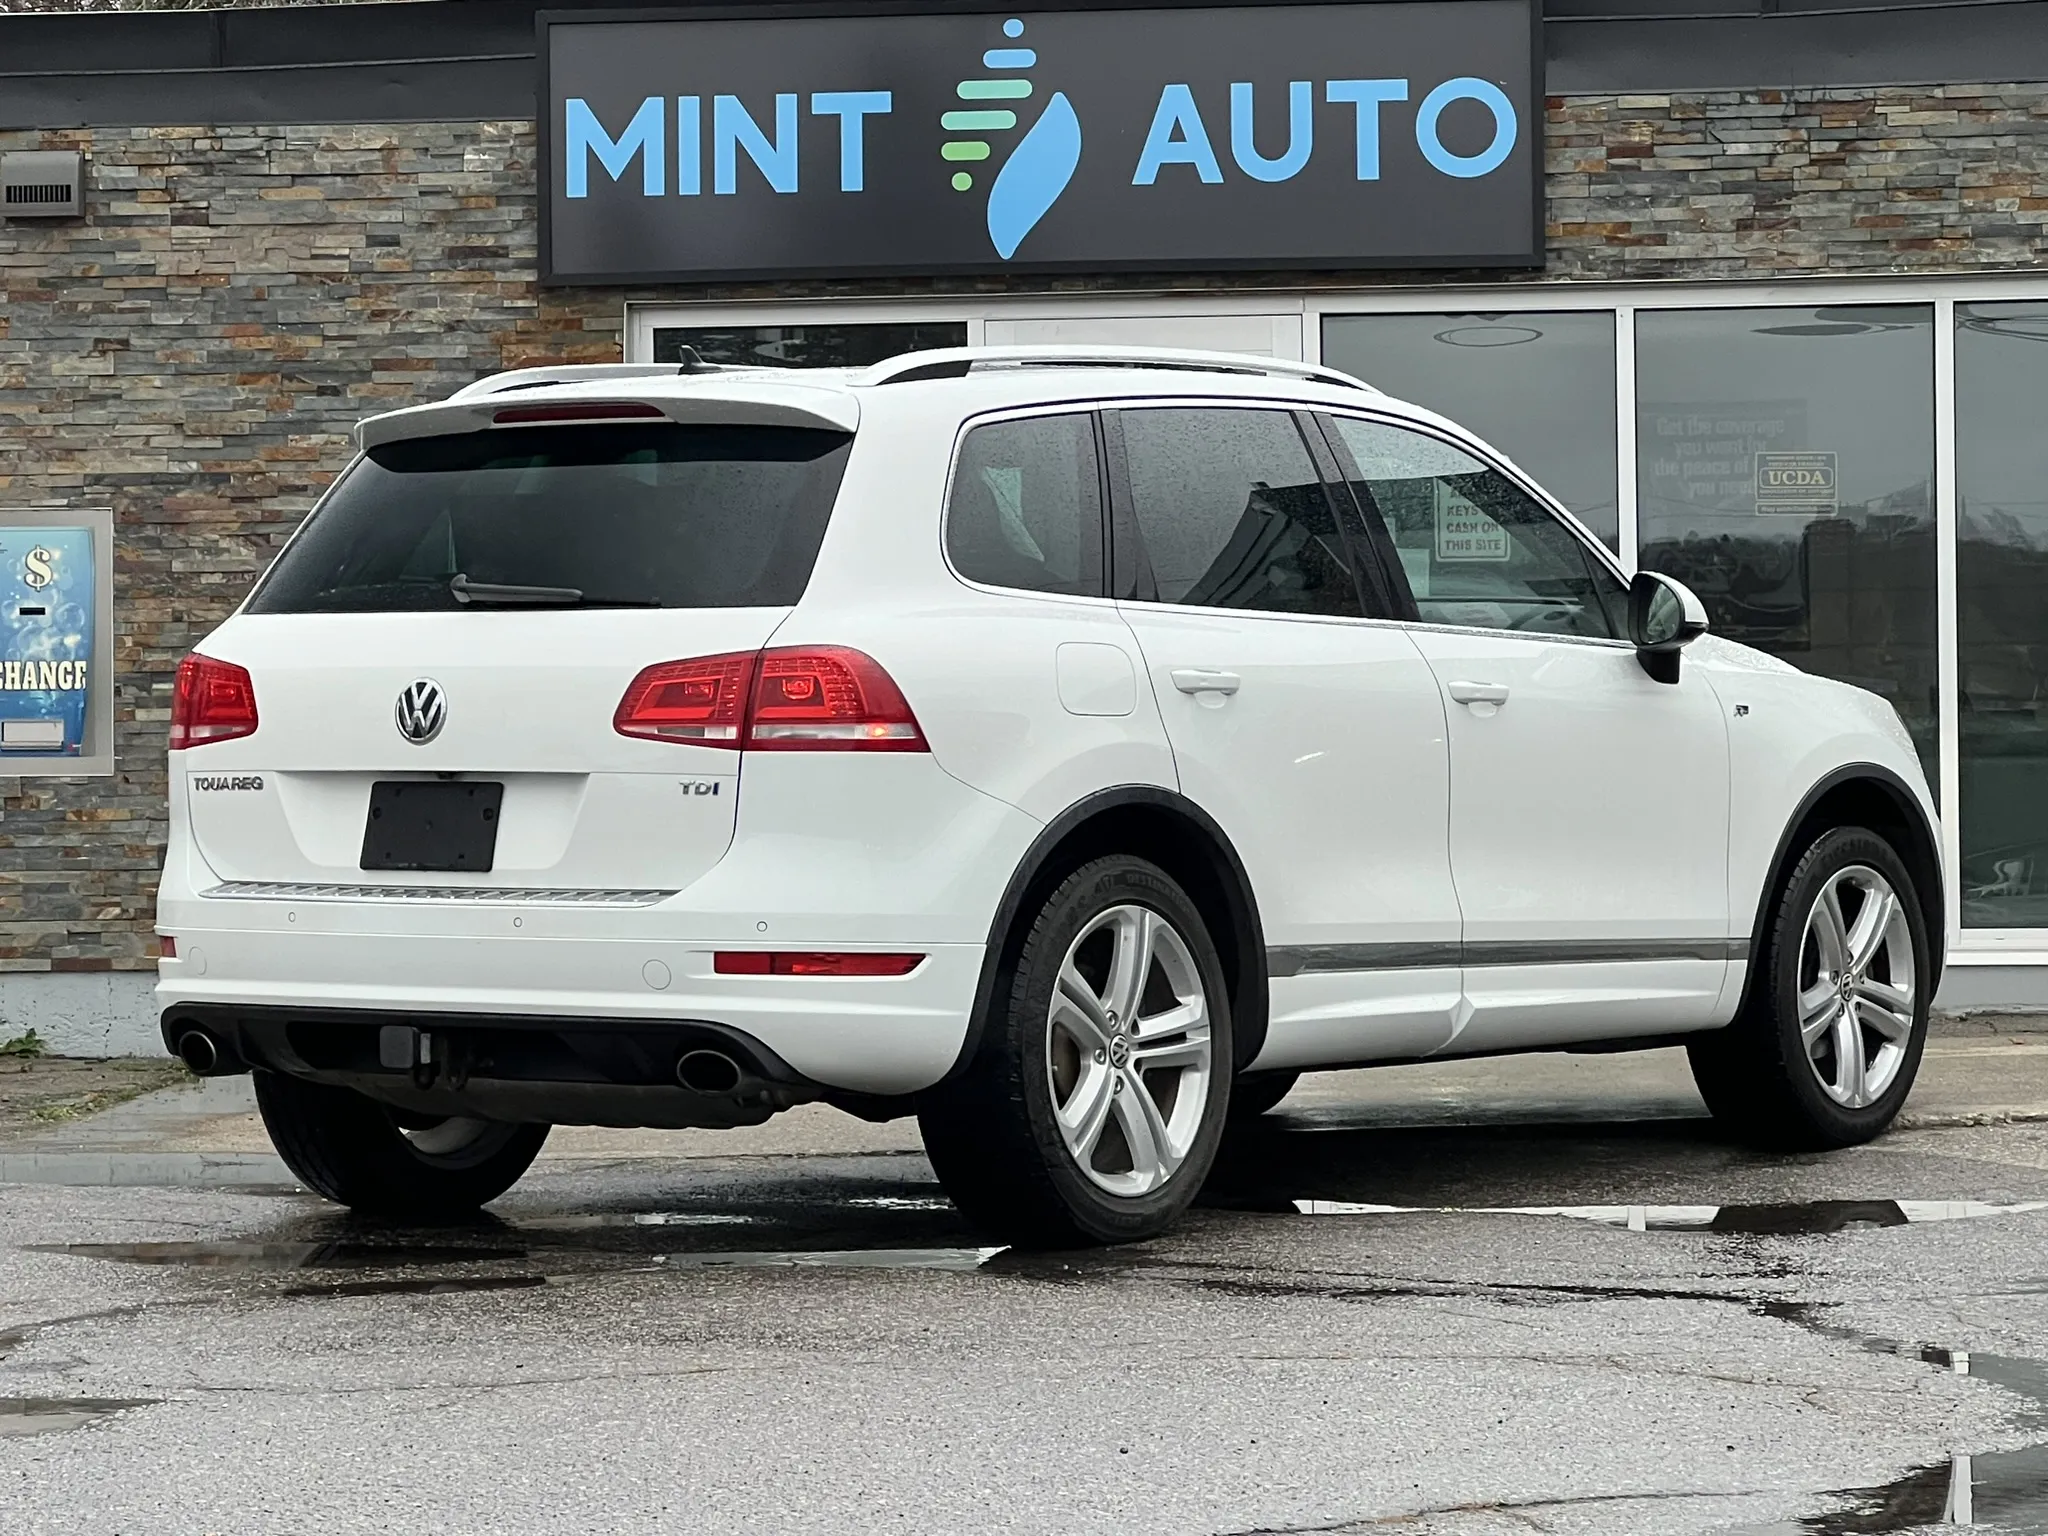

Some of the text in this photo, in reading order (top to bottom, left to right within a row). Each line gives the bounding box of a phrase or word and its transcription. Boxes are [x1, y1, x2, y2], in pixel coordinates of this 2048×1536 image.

[565, 76, 1518, 199] MINT AUTO
[1657, 417, 1684, 436] Get
[1687, 413, 1712, 436] the
[1673, 440, 1701, 459] you
[1705, 438, 1744, 455] want
[1655, 457, 1680, 476] the
[1683, 460, 1730, 480] peace
[1768, 470, 1826, 486] UCDA
[1688, 480, 1715, 500] you
[1447, 504, 1479, 517] KEYS
[1446, 522, 1478, 534] CASH
[1444, 539, 1502, 551] THIS SITE
[0, 660, 87, 690] HANGE
[193, 776, 264, 791] TOUAREG
[679, 781, 720, 796] TDI
